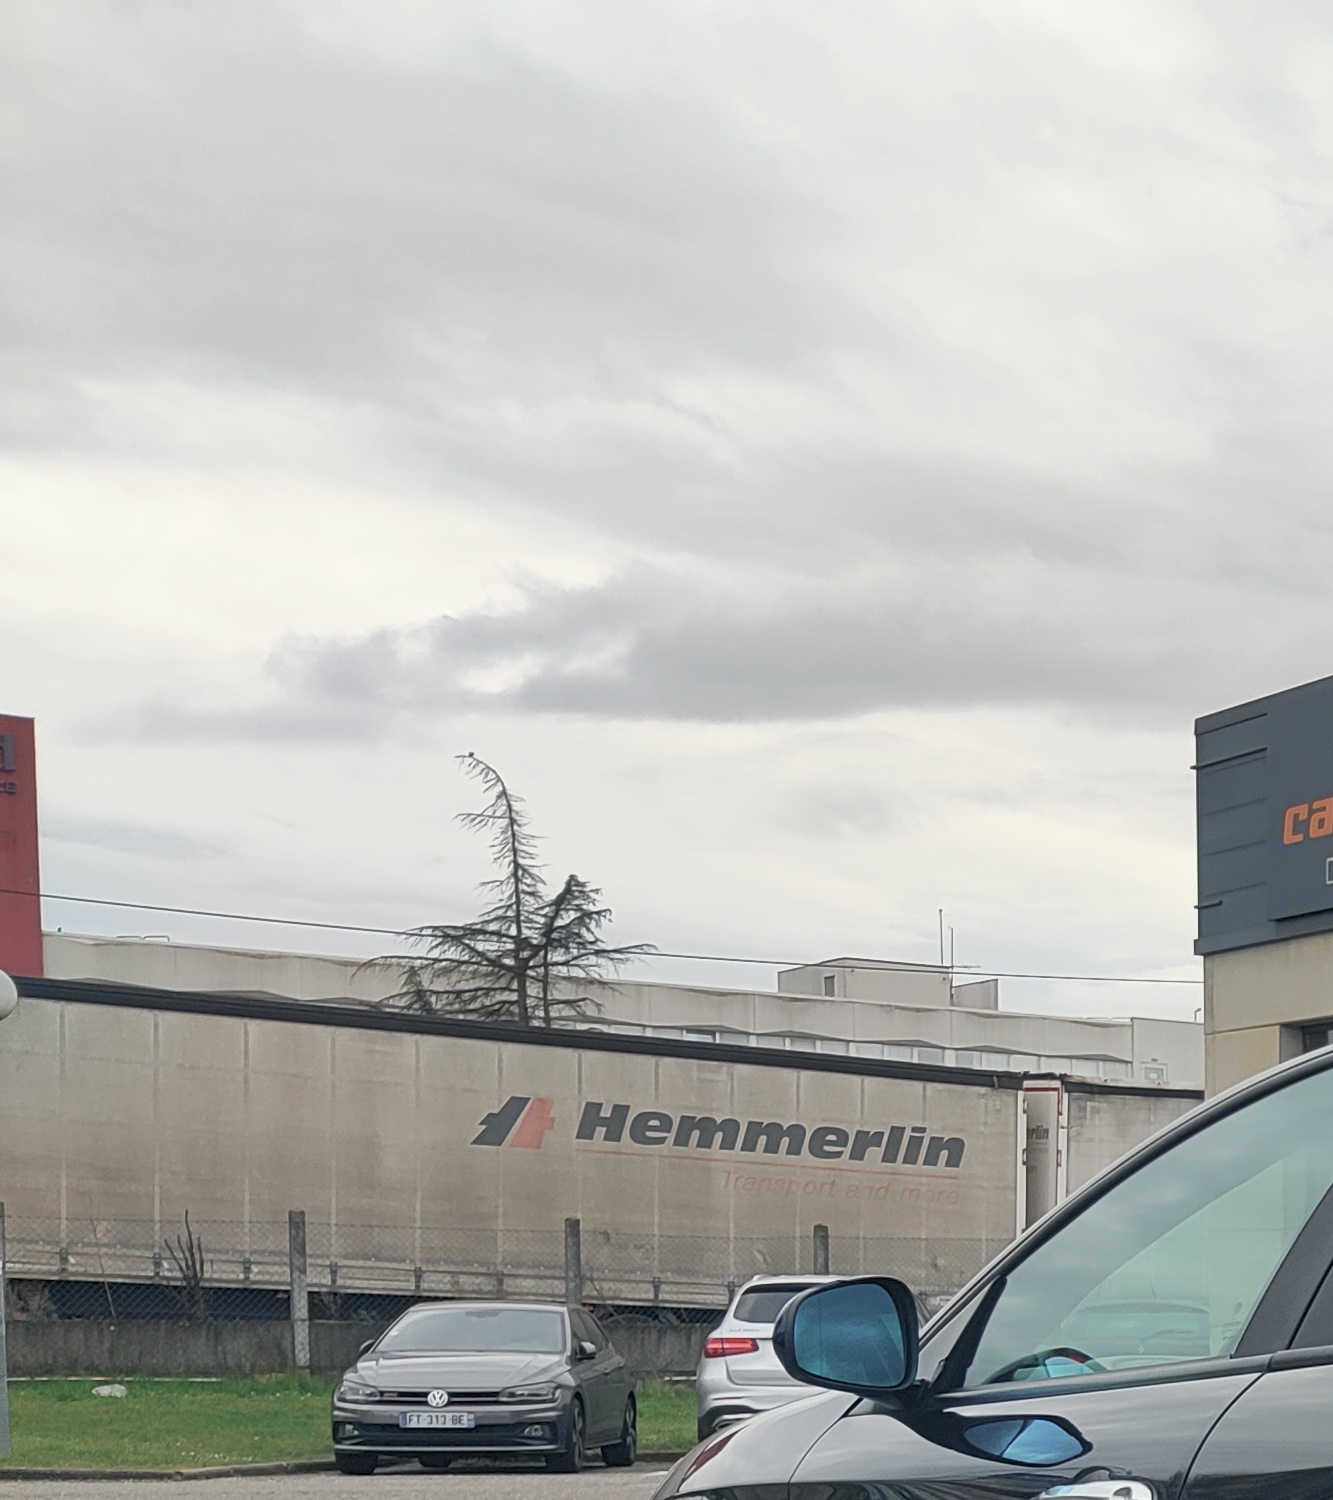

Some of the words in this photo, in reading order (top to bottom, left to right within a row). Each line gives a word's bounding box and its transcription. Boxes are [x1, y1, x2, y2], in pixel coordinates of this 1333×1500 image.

[576, 1100, 966, 1169] Hemmerlin
[723, 1170, 837, 1200] Transport
[845, 1182, 892, 1200] and
